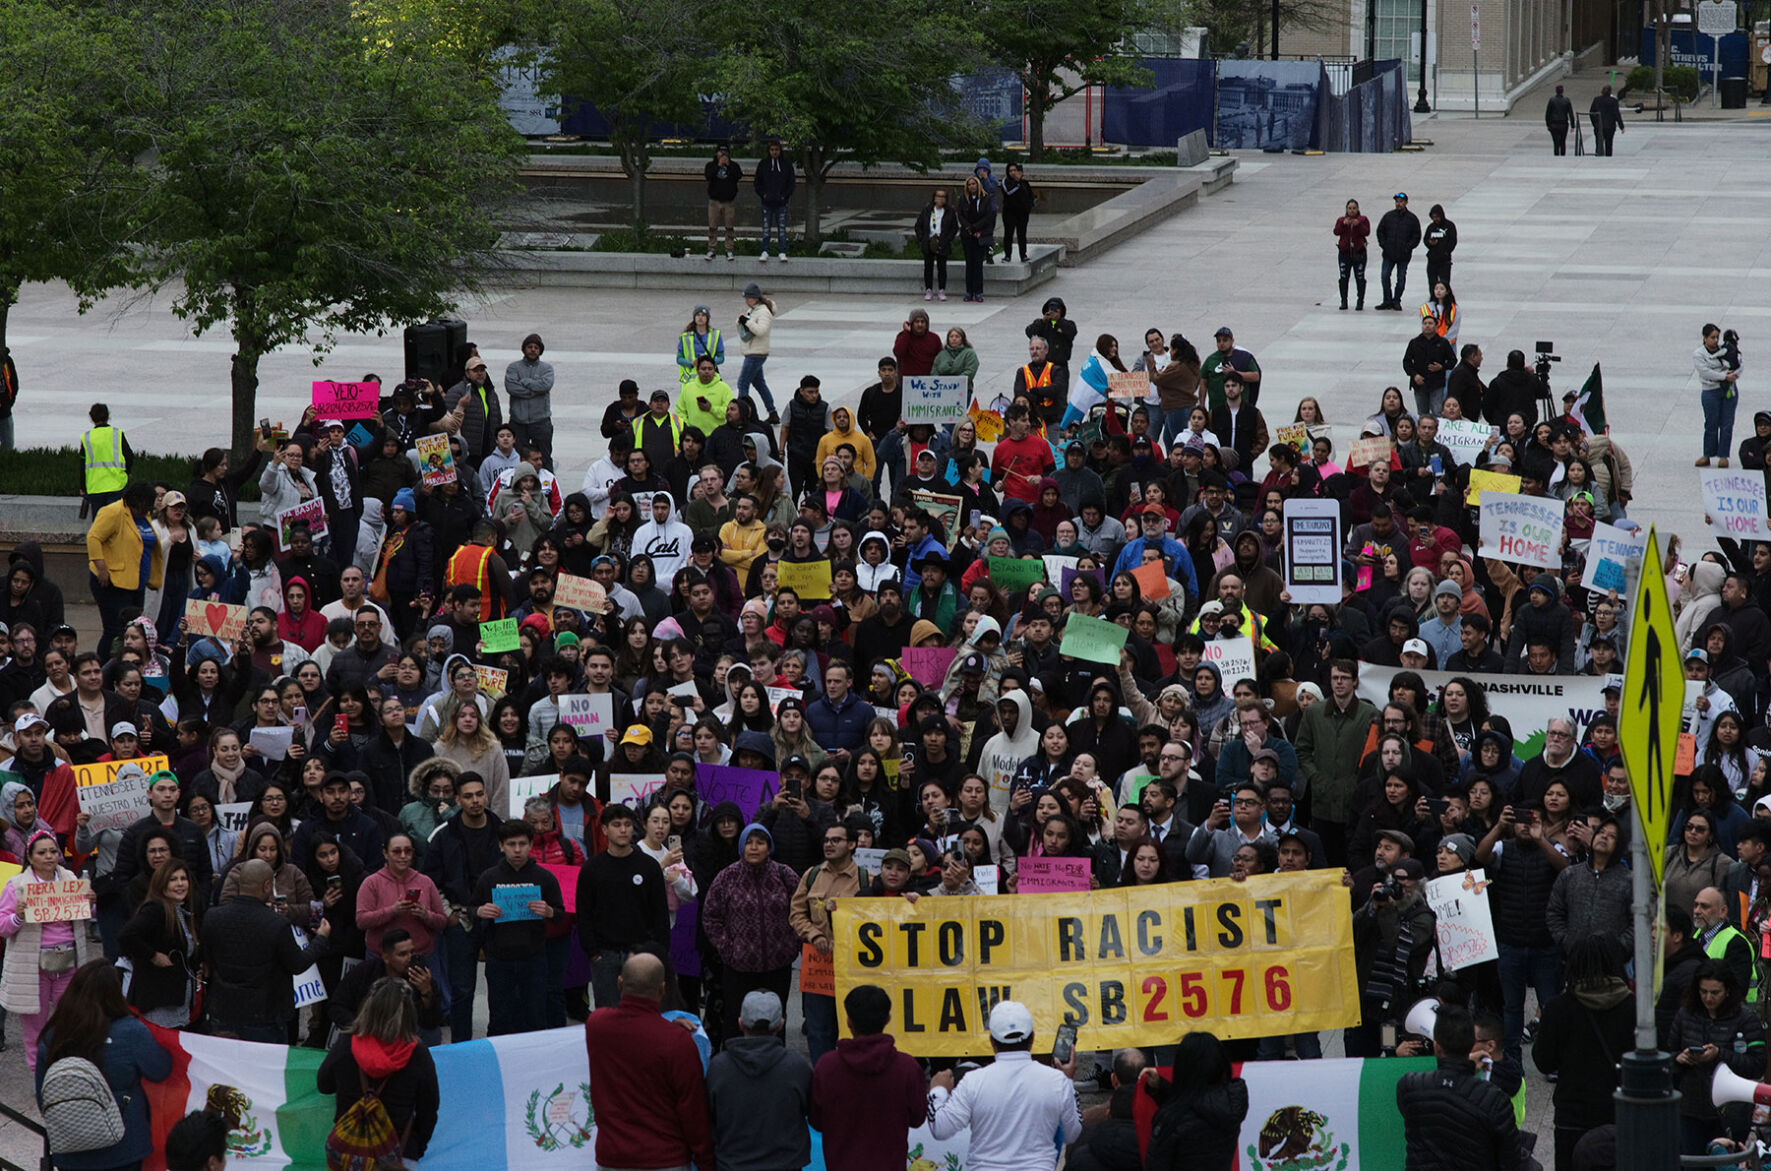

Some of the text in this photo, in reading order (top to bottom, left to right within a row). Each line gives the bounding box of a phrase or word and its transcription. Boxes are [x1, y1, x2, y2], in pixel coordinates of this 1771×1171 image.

[1717, 496, 1759, 514] IS OUR
[1499, 519, 1552, 545] IS OUR
[1725, 515, 1760, 534] HOME
[1500, 535, 1550, 563] HOME
[1205, 645, 1223, 662] NO
[1479, 682, 1564, 697] NASHVILLE
[571, 700, 590, 713] NO
[561, 712, 600, 726] HUMAN
[993, 754, 1021, 771] Model
[133, 796, 150, 808] HO
[27, 880, 85, 897] FUERA LEY
[858, 899, 1283, 969] STOP RACIST
[1063, 982, 1127, 1028] SB
[1141, 965, 1293, 1022] 2576
